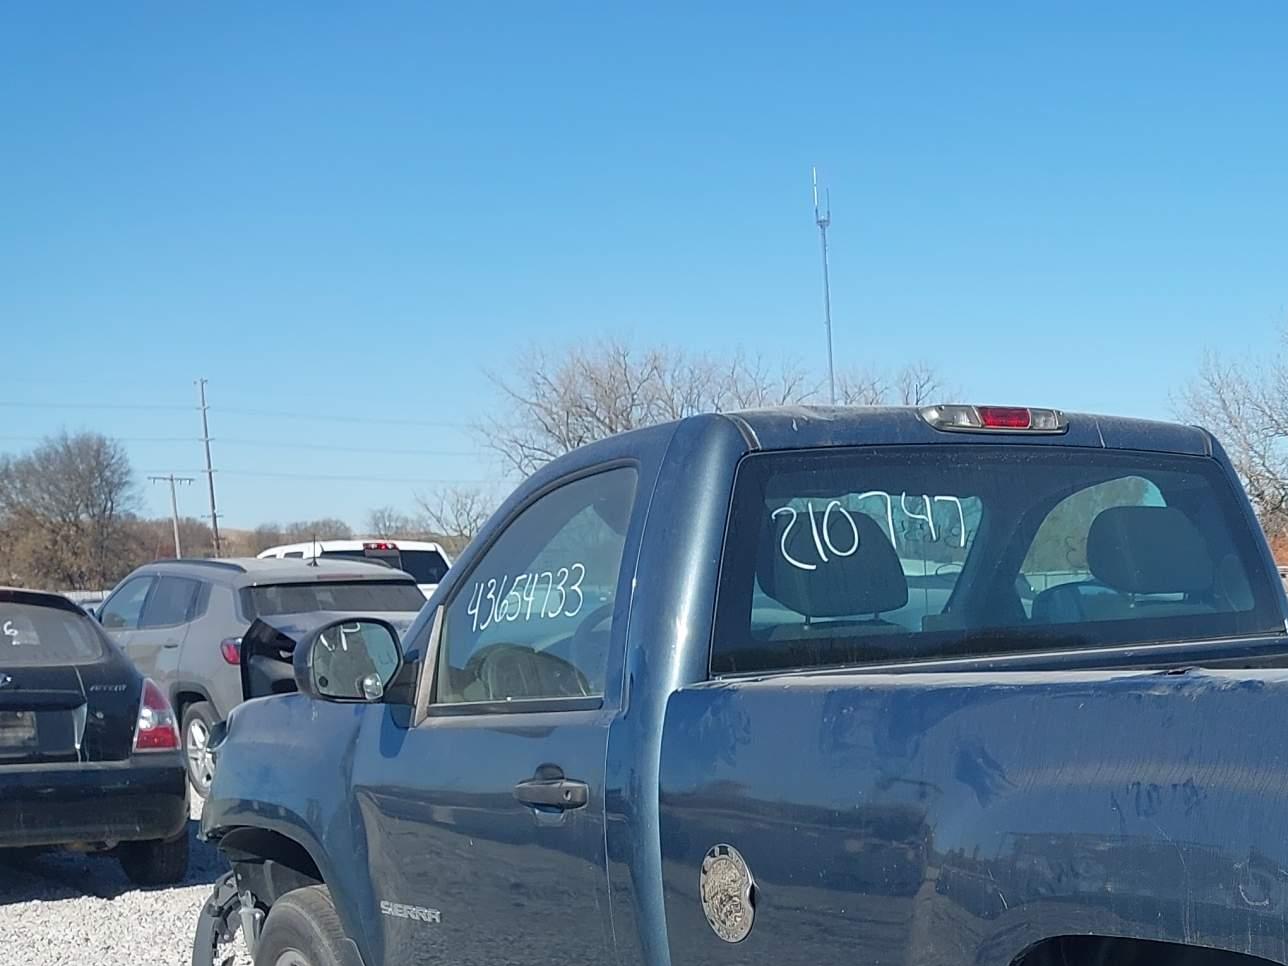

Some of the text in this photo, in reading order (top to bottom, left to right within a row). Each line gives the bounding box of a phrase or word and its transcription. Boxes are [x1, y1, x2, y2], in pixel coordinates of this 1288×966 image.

[772, 491, 965, 570] 210747
[467, 563, 585, 632] 43654733
[380, 900, 441, 923] SIERRA
